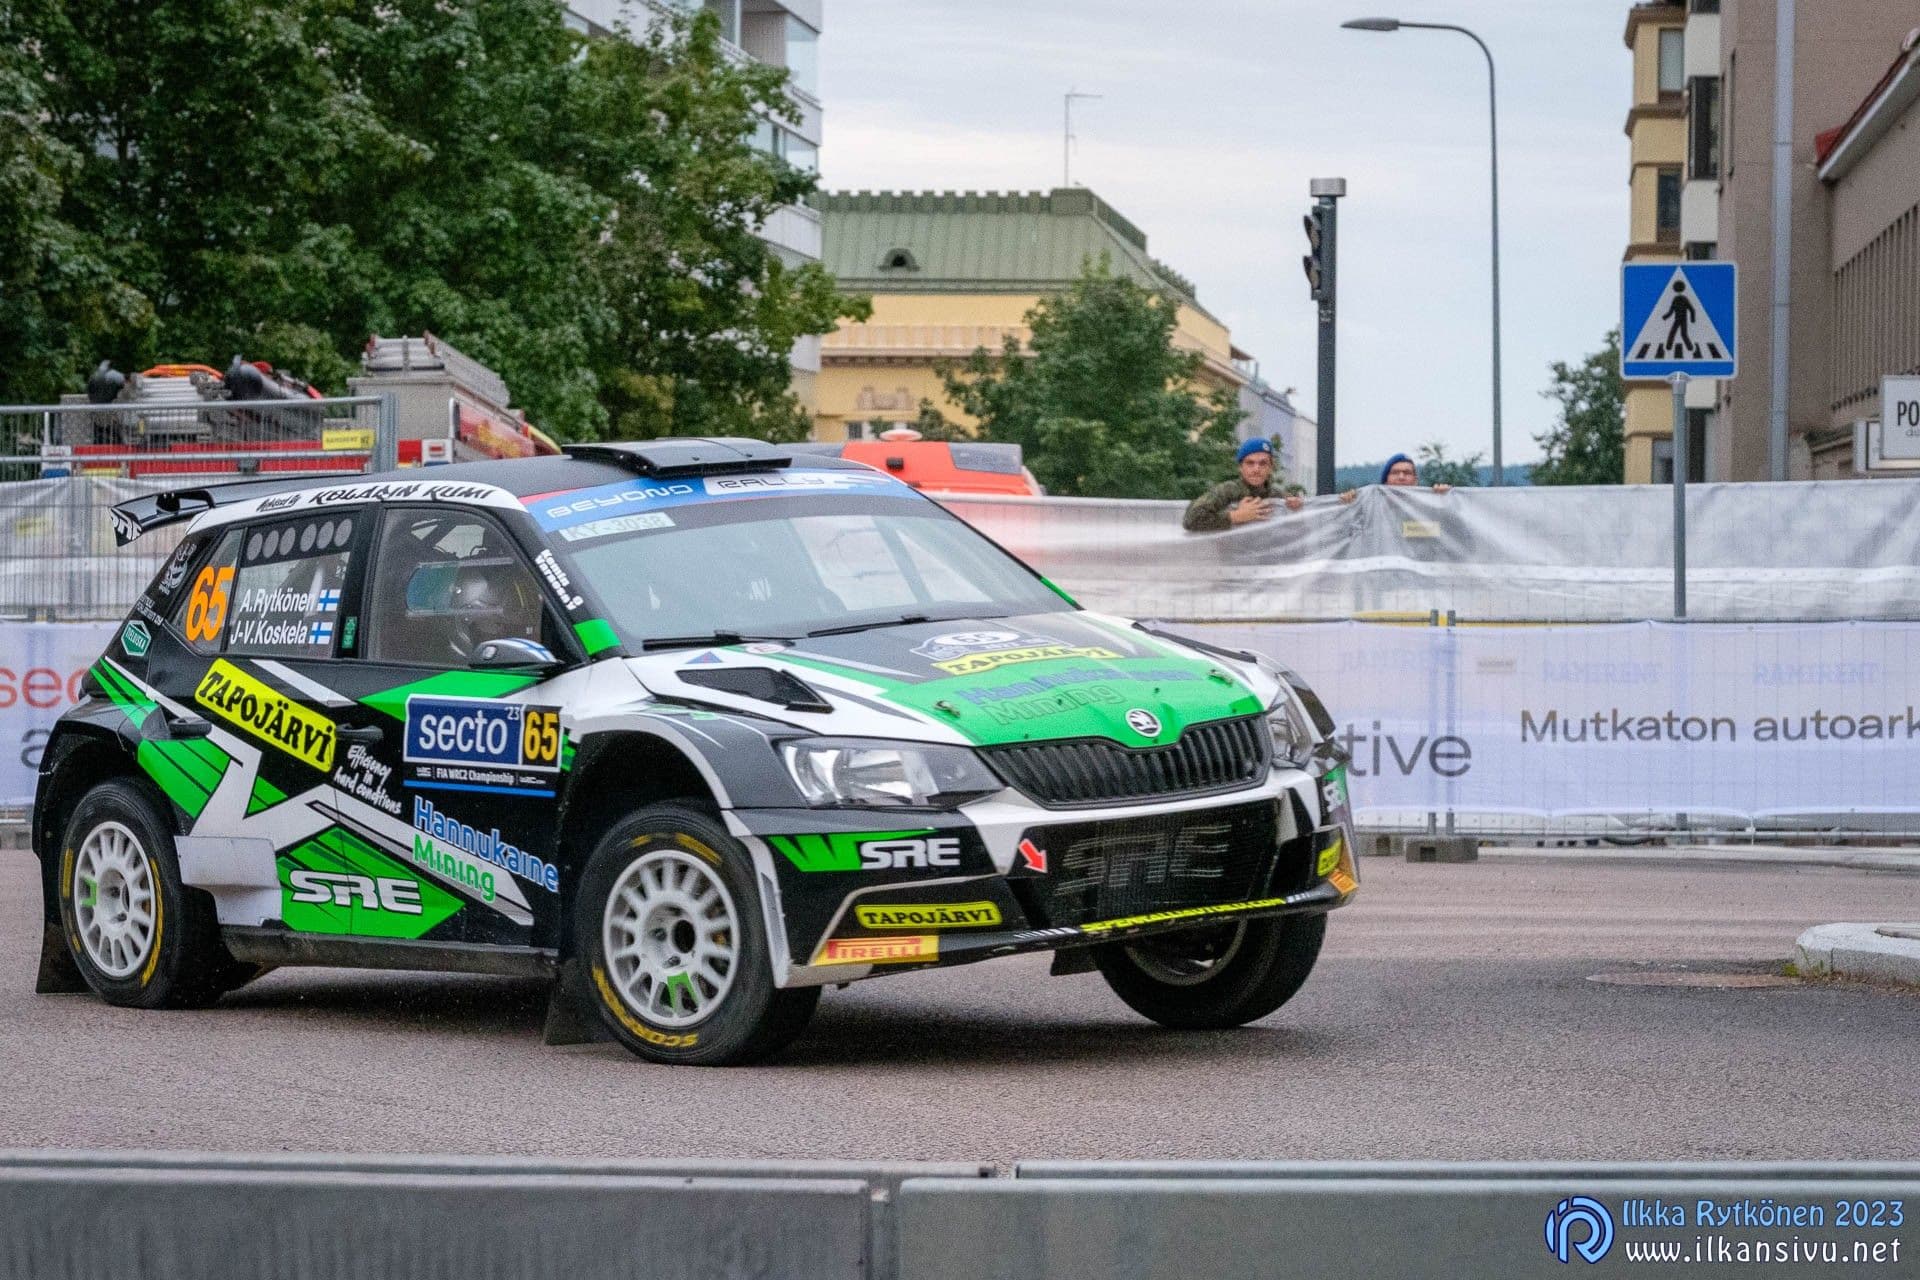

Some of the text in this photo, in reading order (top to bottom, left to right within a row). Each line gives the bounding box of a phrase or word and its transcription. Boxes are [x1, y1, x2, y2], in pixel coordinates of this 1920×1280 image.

[1897, 400, 1920, 427] PO
[308, 483, 423, 505] KOLARIN
[424, 485, 496, 502] KUMI
[546, 477, 825, 519] BEYOND RALLY
[186, 566, 236, 641] 65
[240, 588, 316, 619] A.Rytkönen
[230, 620, 309, 646] J-V.Koskela
[953, 631, 998, 644] 65
[199, 671, 333, 763] TAPOJÄRVI
[419, 709, 508, 755] secto
[1521, 706, 1920, 742] Mutkaton autoark
[524, 711, 558, 761] 65
[347, 744, 392, 787] Efficiency
[362, 769, 374, 786] in
[469, 770, 515, 786] Championship
[356, 783, 402, 815] conditions
[412, 833, 497, 902] Mining
[860, 838, 961, 869] SRE
[289, 870, 423, 915] SRE
[863, 907, 995, 926] TAPOJÄRVI
[825, 937, 923, 960] PIRELLI
